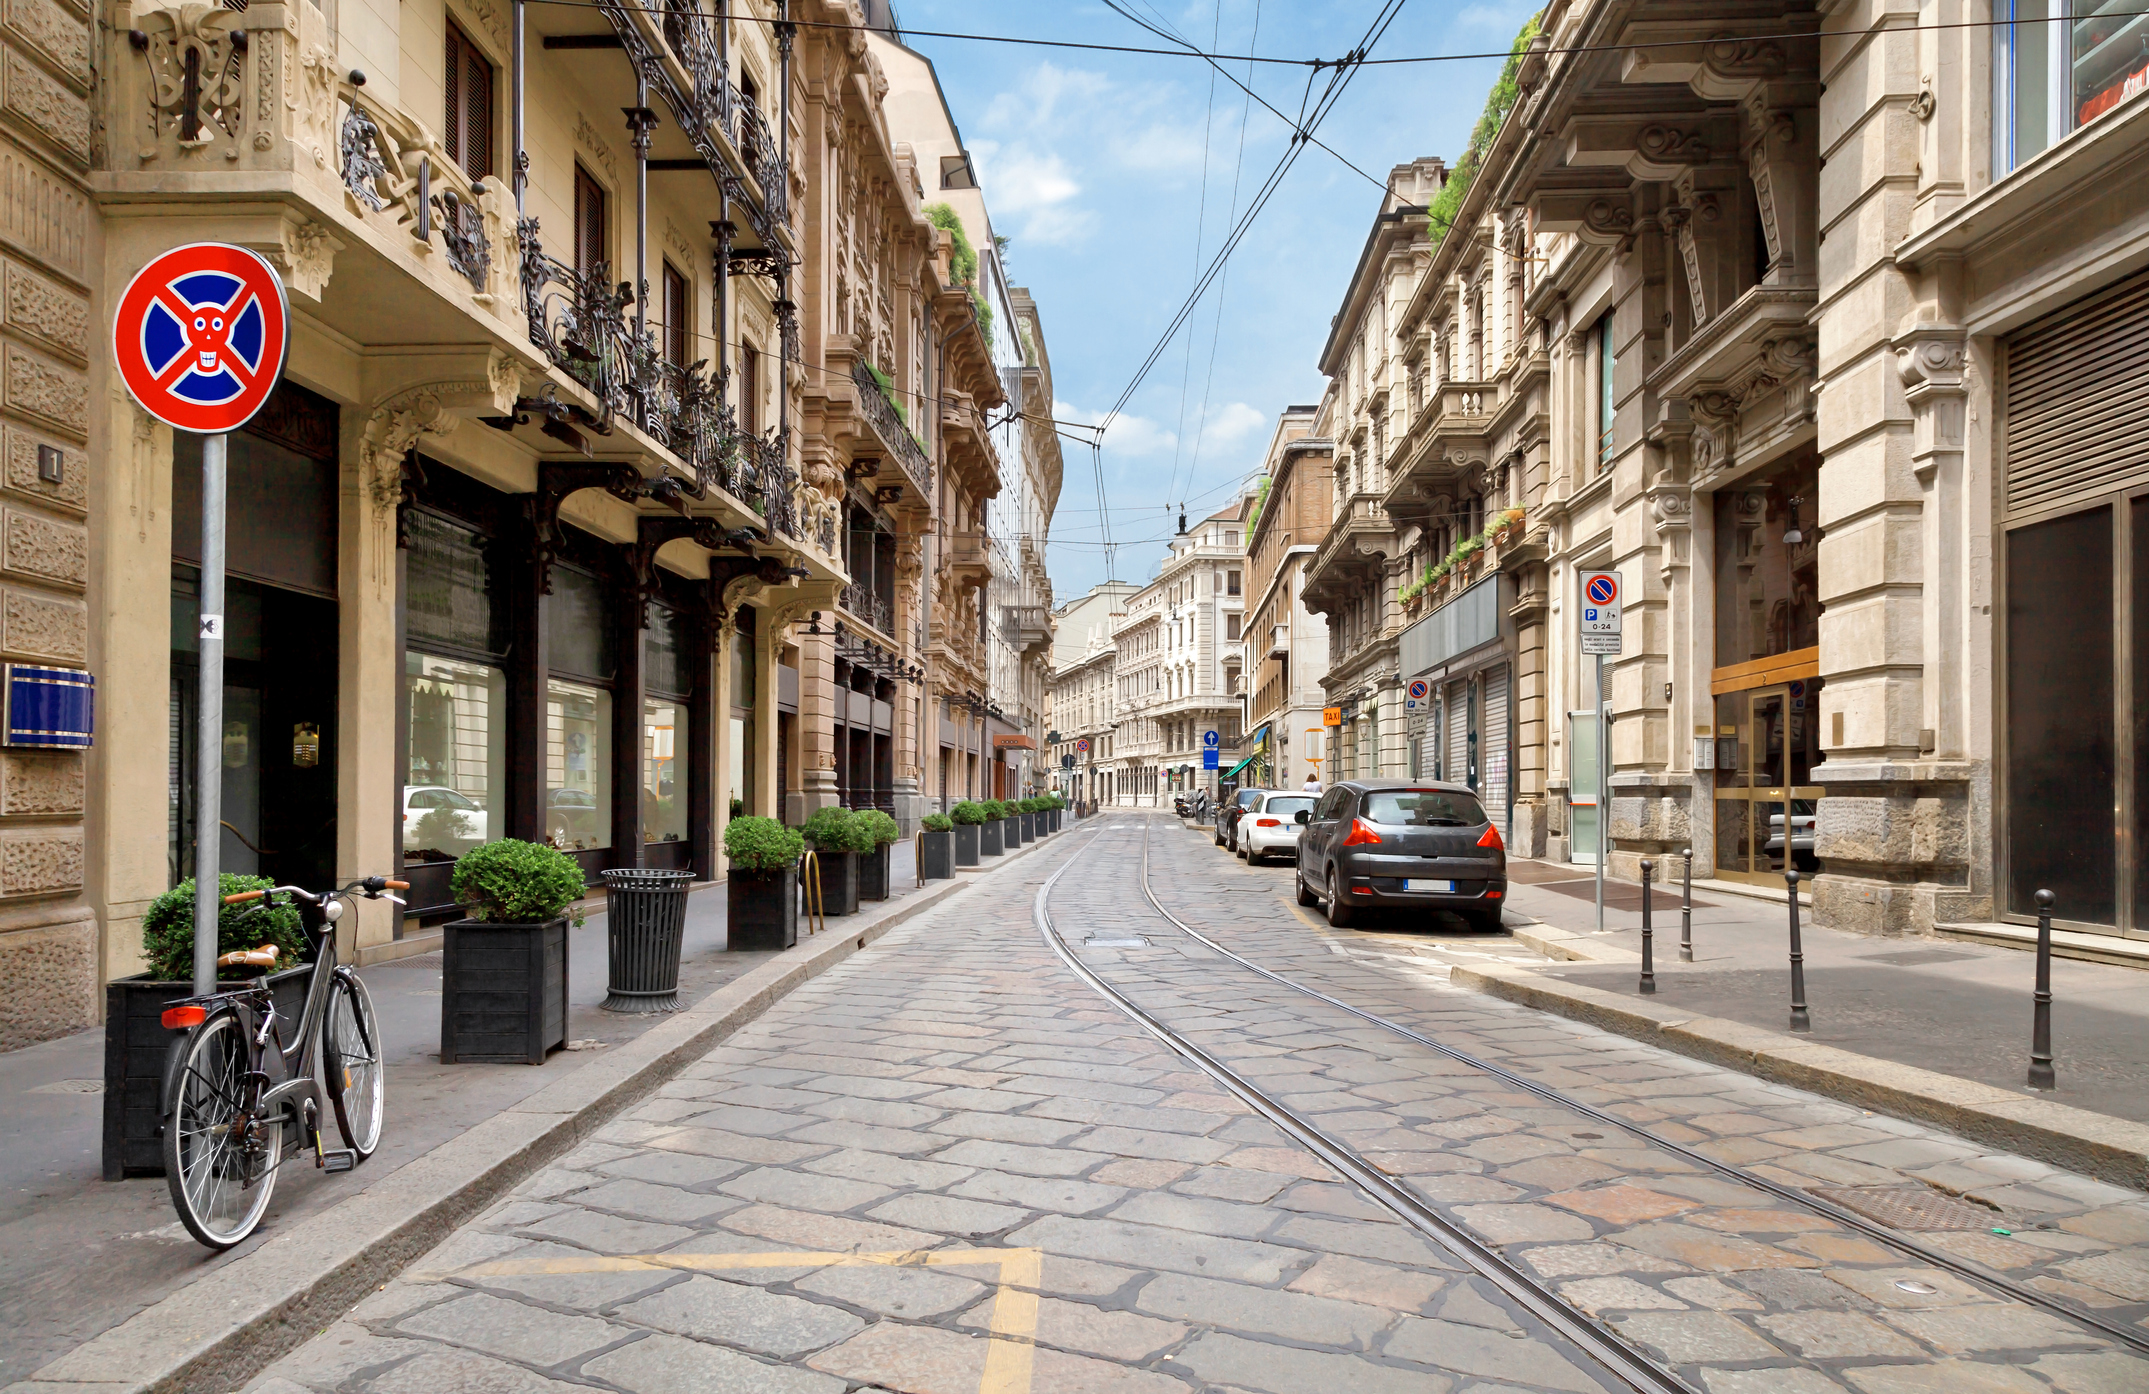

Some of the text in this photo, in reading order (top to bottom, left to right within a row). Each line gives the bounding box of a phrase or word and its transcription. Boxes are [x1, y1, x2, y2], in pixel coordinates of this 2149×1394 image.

[50, 452, 58, 477] 1
[1587, 610, 1595, 619] P
[1325, 711, 1340, 721] TAXI
